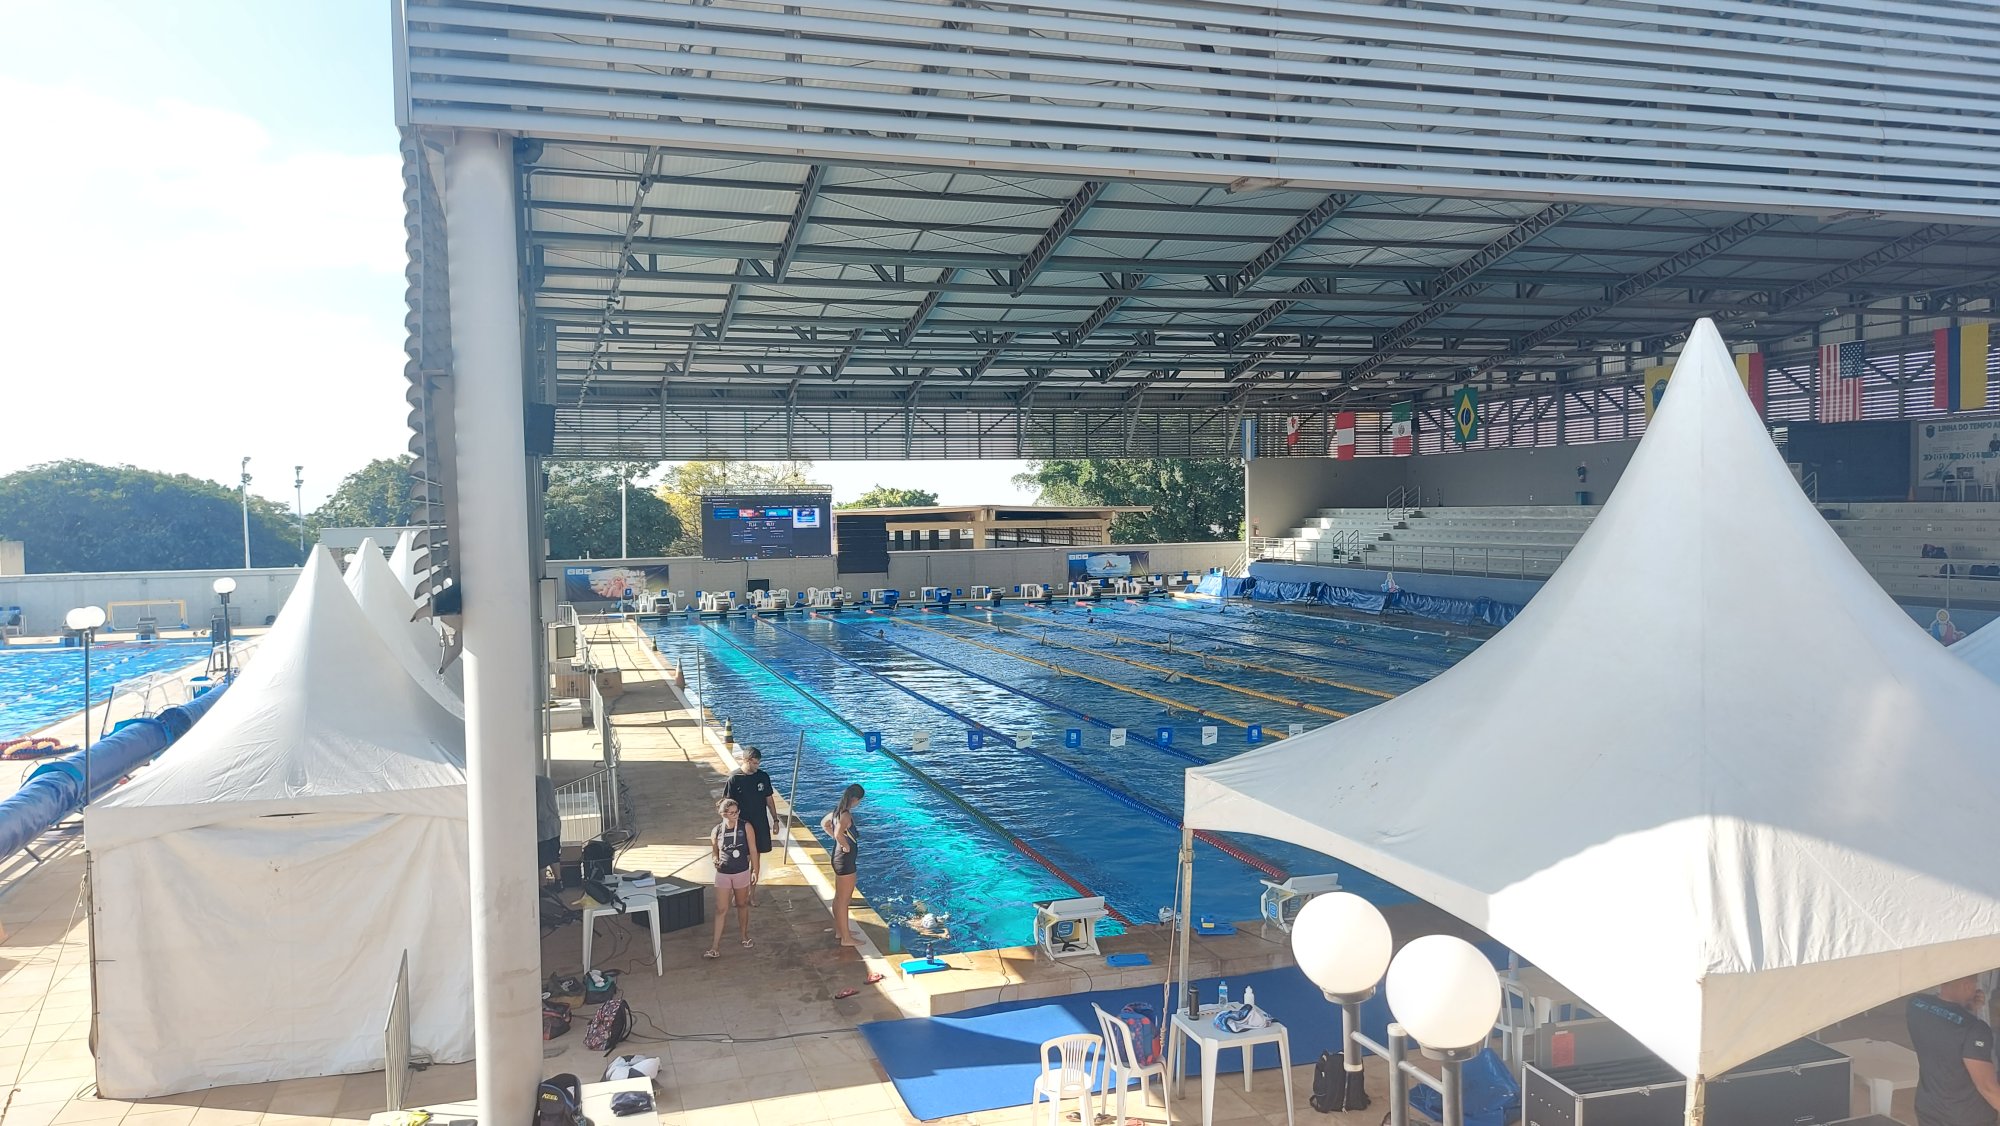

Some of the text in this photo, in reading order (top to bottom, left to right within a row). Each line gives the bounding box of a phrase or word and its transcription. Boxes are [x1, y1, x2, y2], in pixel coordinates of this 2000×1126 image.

[1938, 424, 1957, 432] LINHA
[1969, 421, 1992, 429] TEMPO
[1058, 921, 1074, 937] 9
